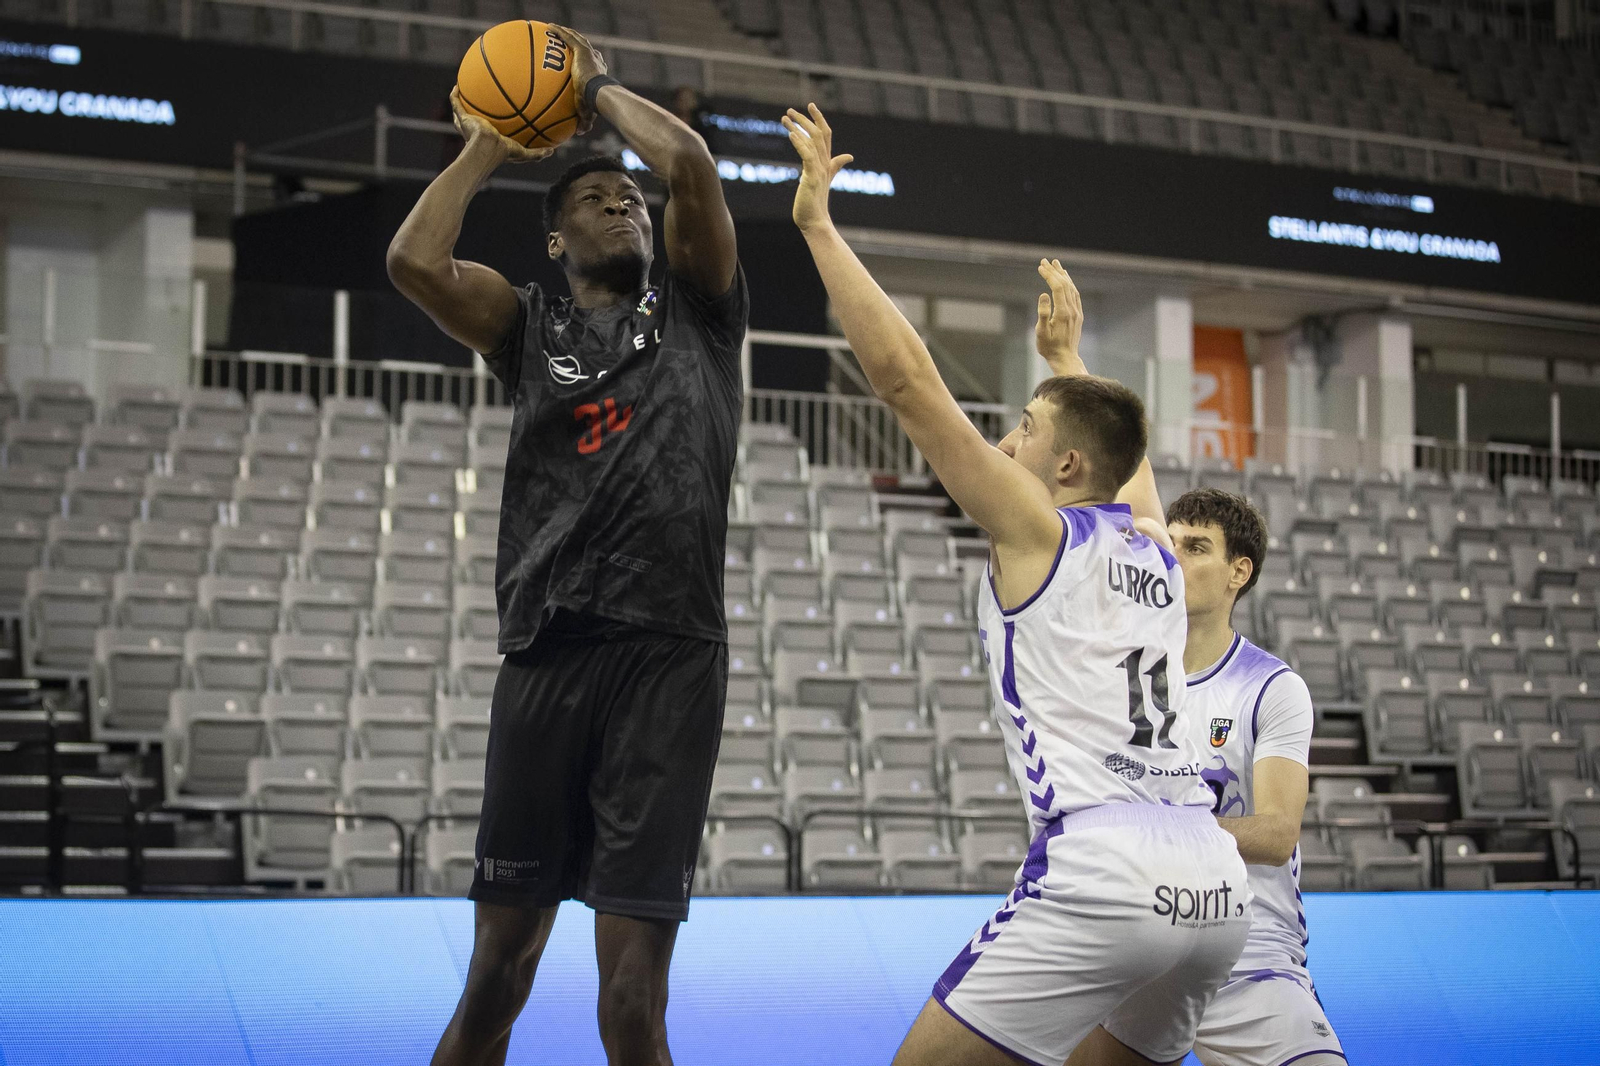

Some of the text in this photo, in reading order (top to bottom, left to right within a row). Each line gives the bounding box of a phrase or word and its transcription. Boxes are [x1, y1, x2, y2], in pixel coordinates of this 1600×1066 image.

[543, 31, 567, 71] Wil
[1268, 215, 1369, 248] STELLANTIS
[1108, 557, 1174, 609] URKO
[1115, 647, 1179, 749] 11
[1212, 719, 1230, 728] LIGA
[496, 868, 516, 878] 2031
